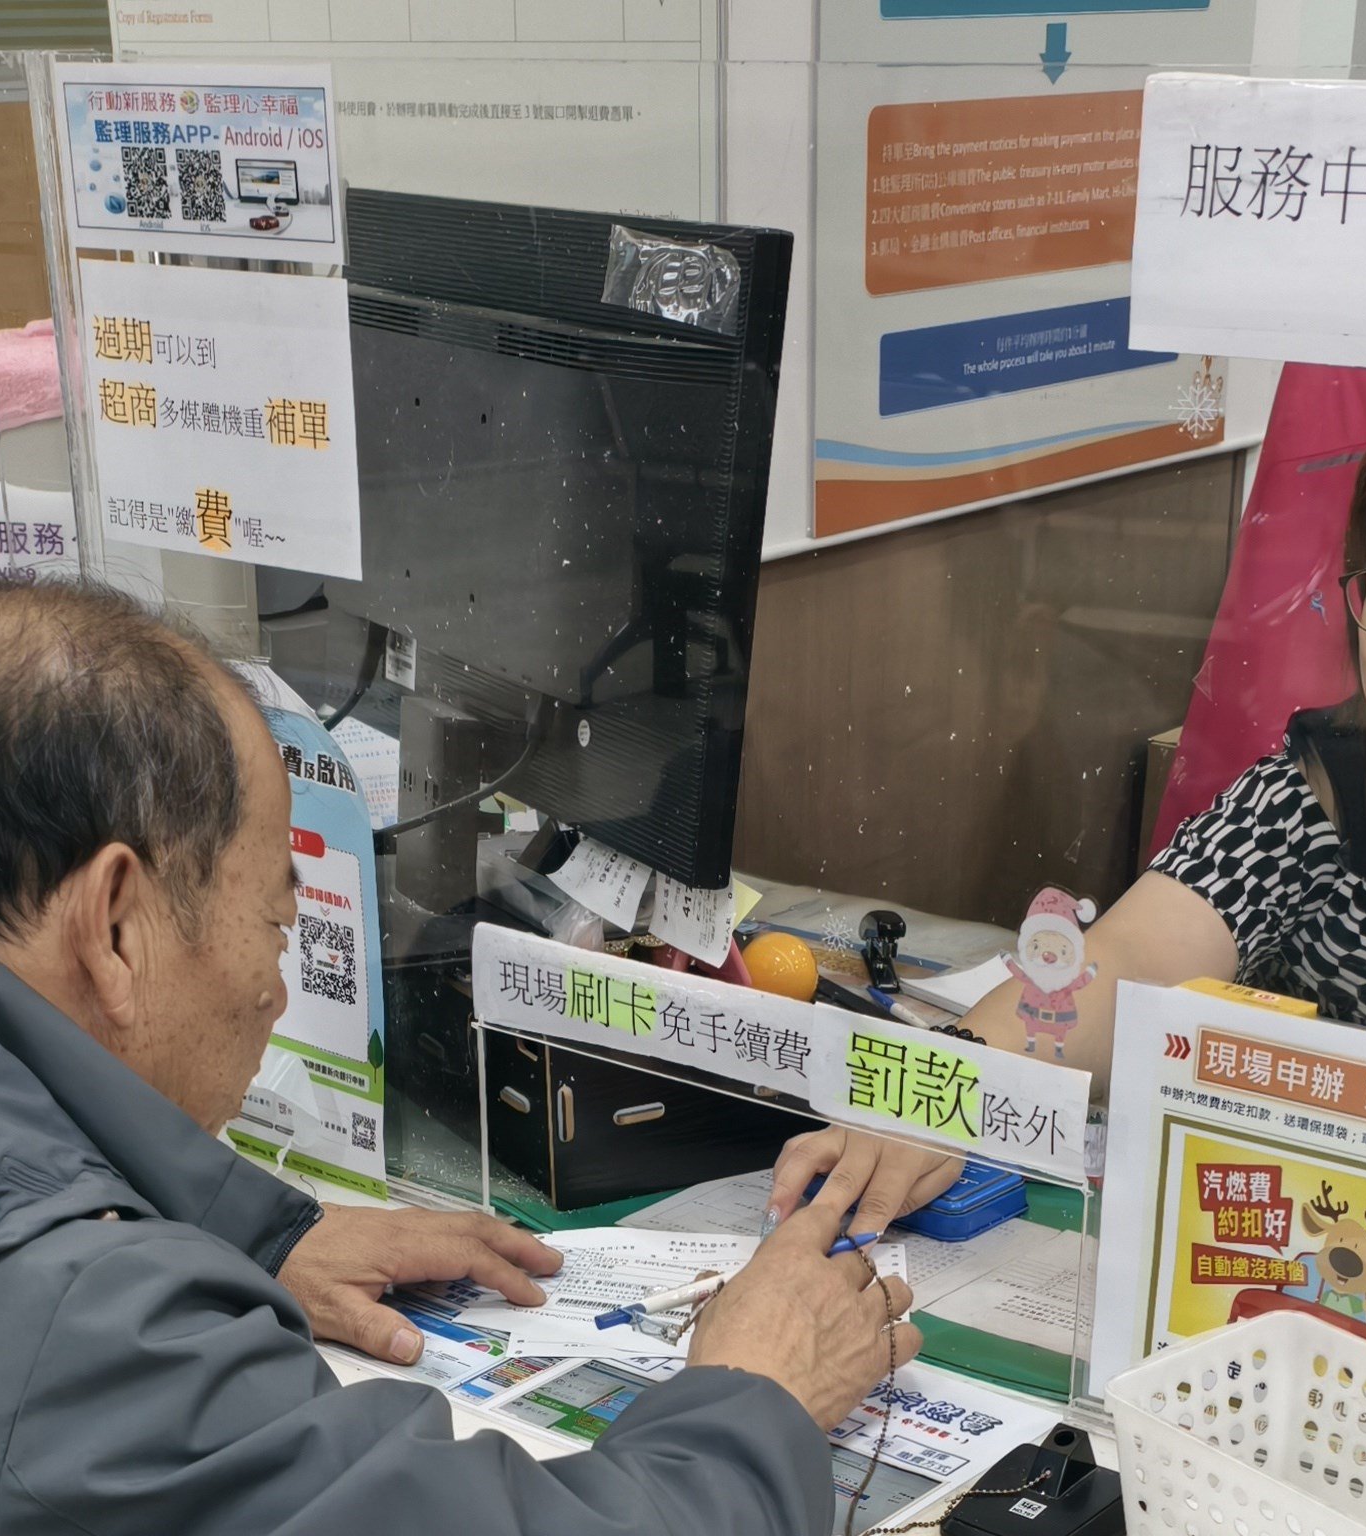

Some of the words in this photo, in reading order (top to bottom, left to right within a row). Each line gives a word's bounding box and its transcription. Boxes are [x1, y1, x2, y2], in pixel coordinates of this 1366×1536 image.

[88, 90, 175, 113] 行動新服務
[203, 91, 299, 116] 監理心幸福
[94, 119, 219, 145] 監理服務APP-
[224, 126, 282, 148] Android
[287, 127, 293, 149] /
[298, 128, 324, 149] iOS
[937, 143, 950, 156] the
[953, 141, 988, 156] payment
[990, 138, 1018, 151] notices
[1019, 135, 1030, 148] for
[1032, 134, 1059, 149] making
[1061, 132, 1093, 147] payment
[1102, 130, 1114, 142] the
[1066, 189, 1090, 205] Family
[139, 220, 164, 230] Android
[93, 315, 216, 369] 過期可以到
[963, 363, 976, 375] The
[977, 359, 999, 373] whole
[1000, 355, 1026, 371] process
[1026, 352, 1038, 364] will
[1039, 349, 1053, 362] take
[1054, 349, 1067, 363] you
[1068, 344, 1087, 357] about
[1093, 340, 1116, 352] minute
[99, 378, 331, 449] 超商多媒體機重補單
[499, 959, 811, 1078] 現場刷卡免手續費
[1205, 1037, 1345, 1104] 現場申辦
[845, 1032, 1066, 1156] 罰款除外
[1203, 1170, 1271, 1204] 汽燃費
[1218, 1206, 1286, 1241] 約扣好
[1197, 1254, 1305, 1282] 自動繳沒煩惱
[896, 1450, 952, 1474] 繳費方式
